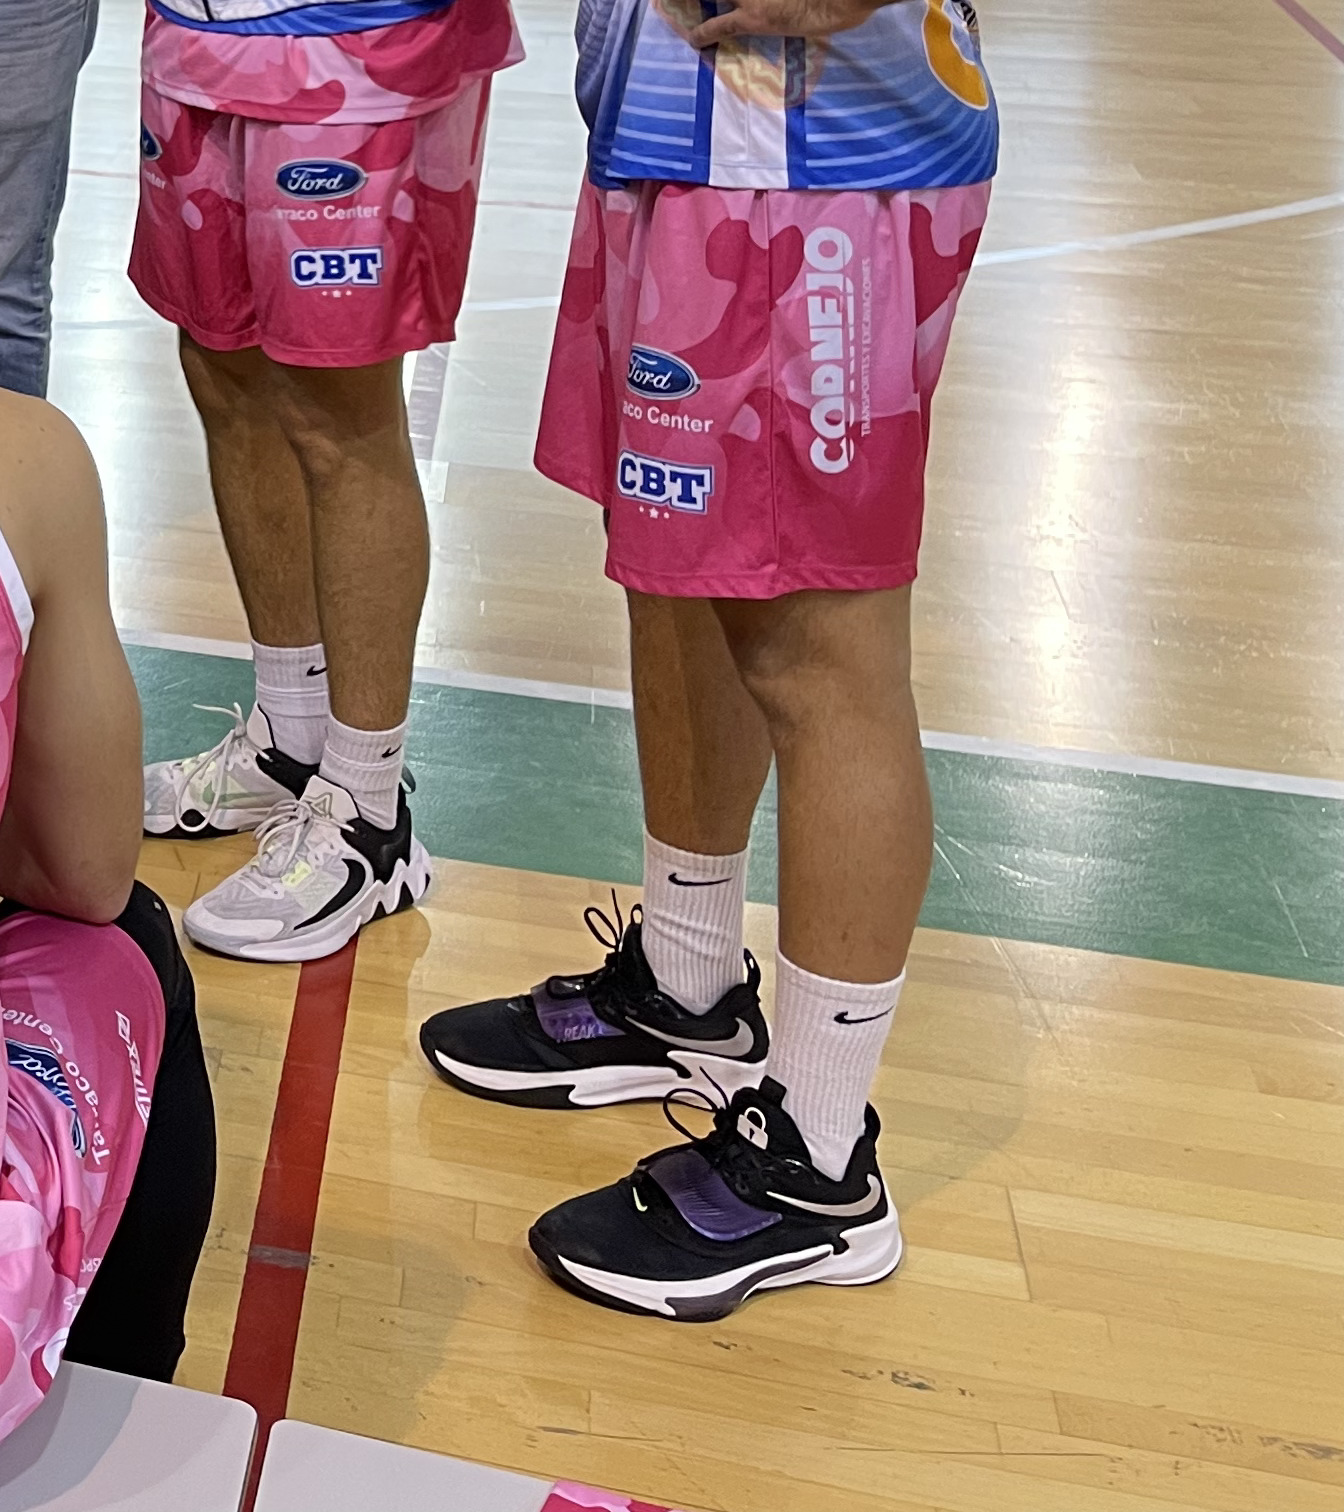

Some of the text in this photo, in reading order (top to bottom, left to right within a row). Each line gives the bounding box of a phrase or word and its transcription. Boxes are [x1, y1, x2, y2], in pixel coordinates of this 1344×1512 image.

[286, 166, 344, 192] Ford
[323, 205, 381, 221] Center
[291, 249, 383, 285] CBT
[627, 358, 673, 391] Ford
[647, 406, 714, 435] Center
[617, 450, 714, 514] CBT
